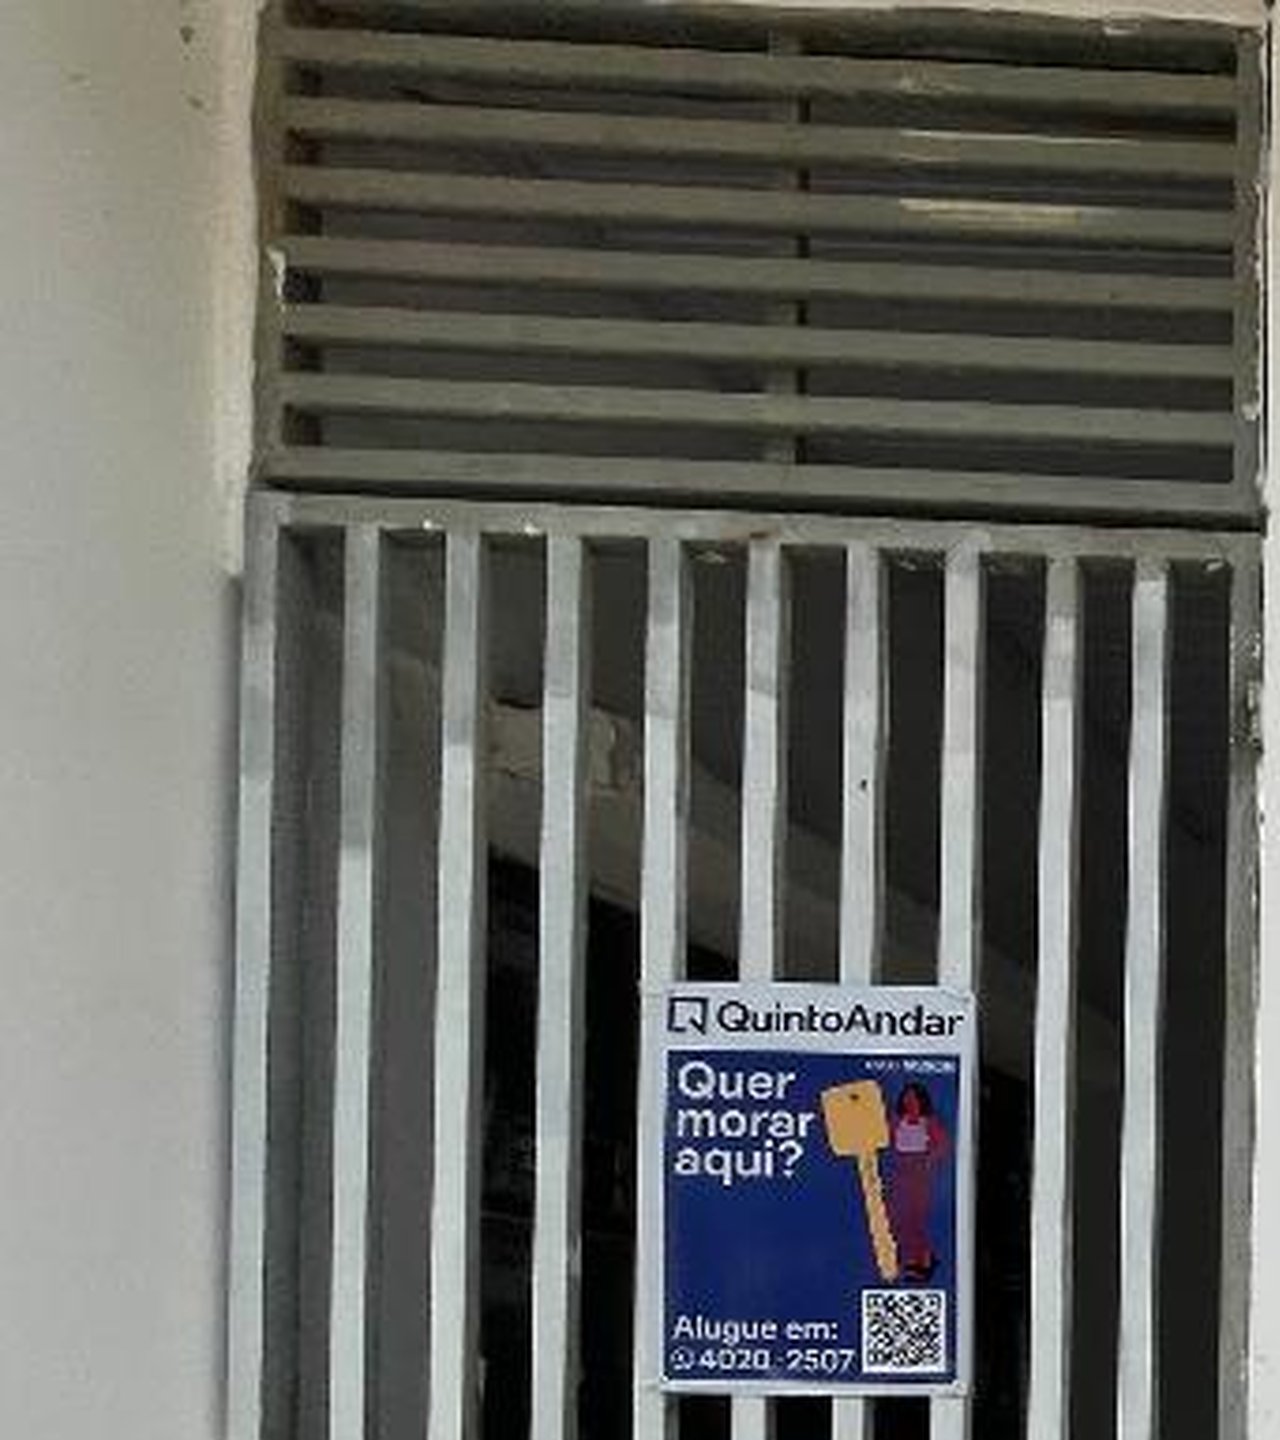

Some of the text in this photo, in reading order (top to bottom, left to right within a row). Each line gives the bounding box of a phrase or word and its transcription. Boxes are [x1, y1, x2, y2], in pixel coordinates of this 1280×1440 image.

[717, 1000, 964, 1036] QuintoAndar
[678, 1060, 797, 1100] Quer
[676, 1106, 816, 1138] morar
[674, 1140, 805, 1187] aqui?
[672, 1315, 839, 1346] Alugue em:
